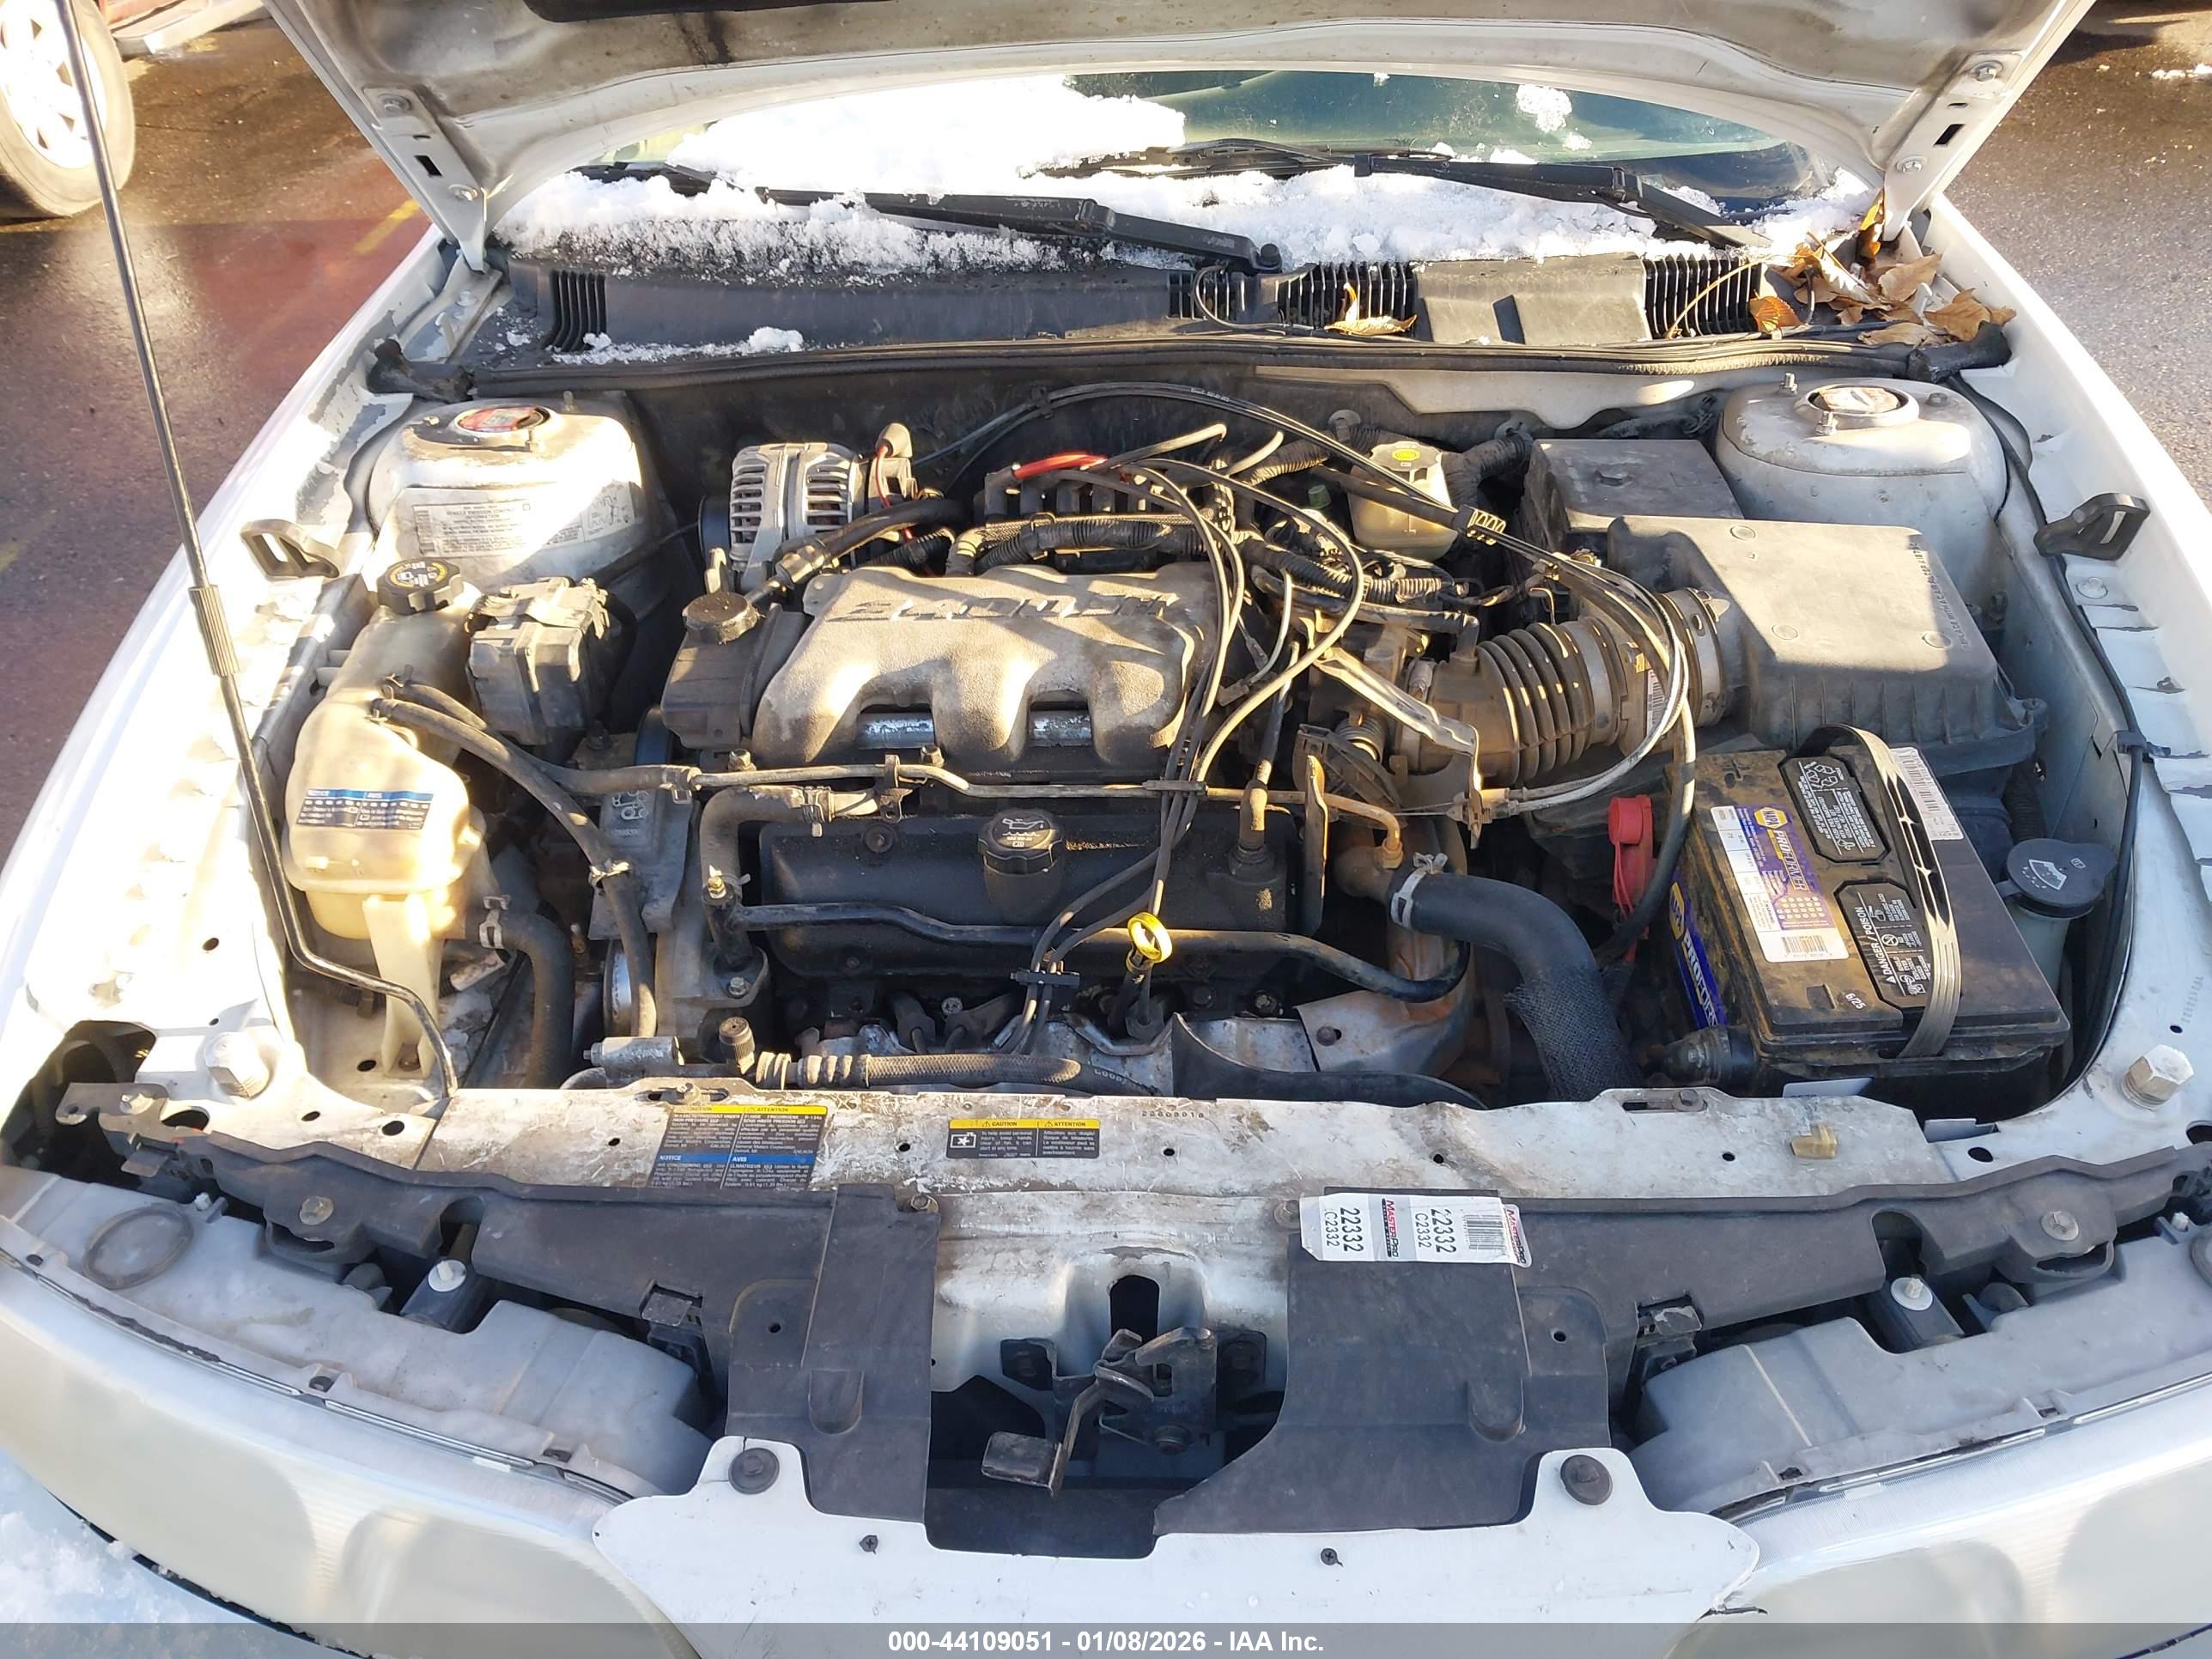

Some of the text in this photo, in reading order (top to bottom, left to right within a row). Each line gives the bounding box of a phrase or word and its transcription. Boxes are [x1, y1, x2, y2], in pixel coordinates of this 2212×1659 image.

[1760, 809, 1779, 826] NAPA
[1772, 830, 1808, 892] PROFORMER
[1854, 906, 1875, 935] POISON
[1869, 942, 1893, 975] DANGER
[1844, 991, 1867, 1011] 6/25
[1324, 1211, 1340, 1247] C2332
[1340, 1206, 1364, 1252] 22332
[1415, 1212, 1432, 1248] C2332
[1431, 1208, 1457, 1254] 22332
